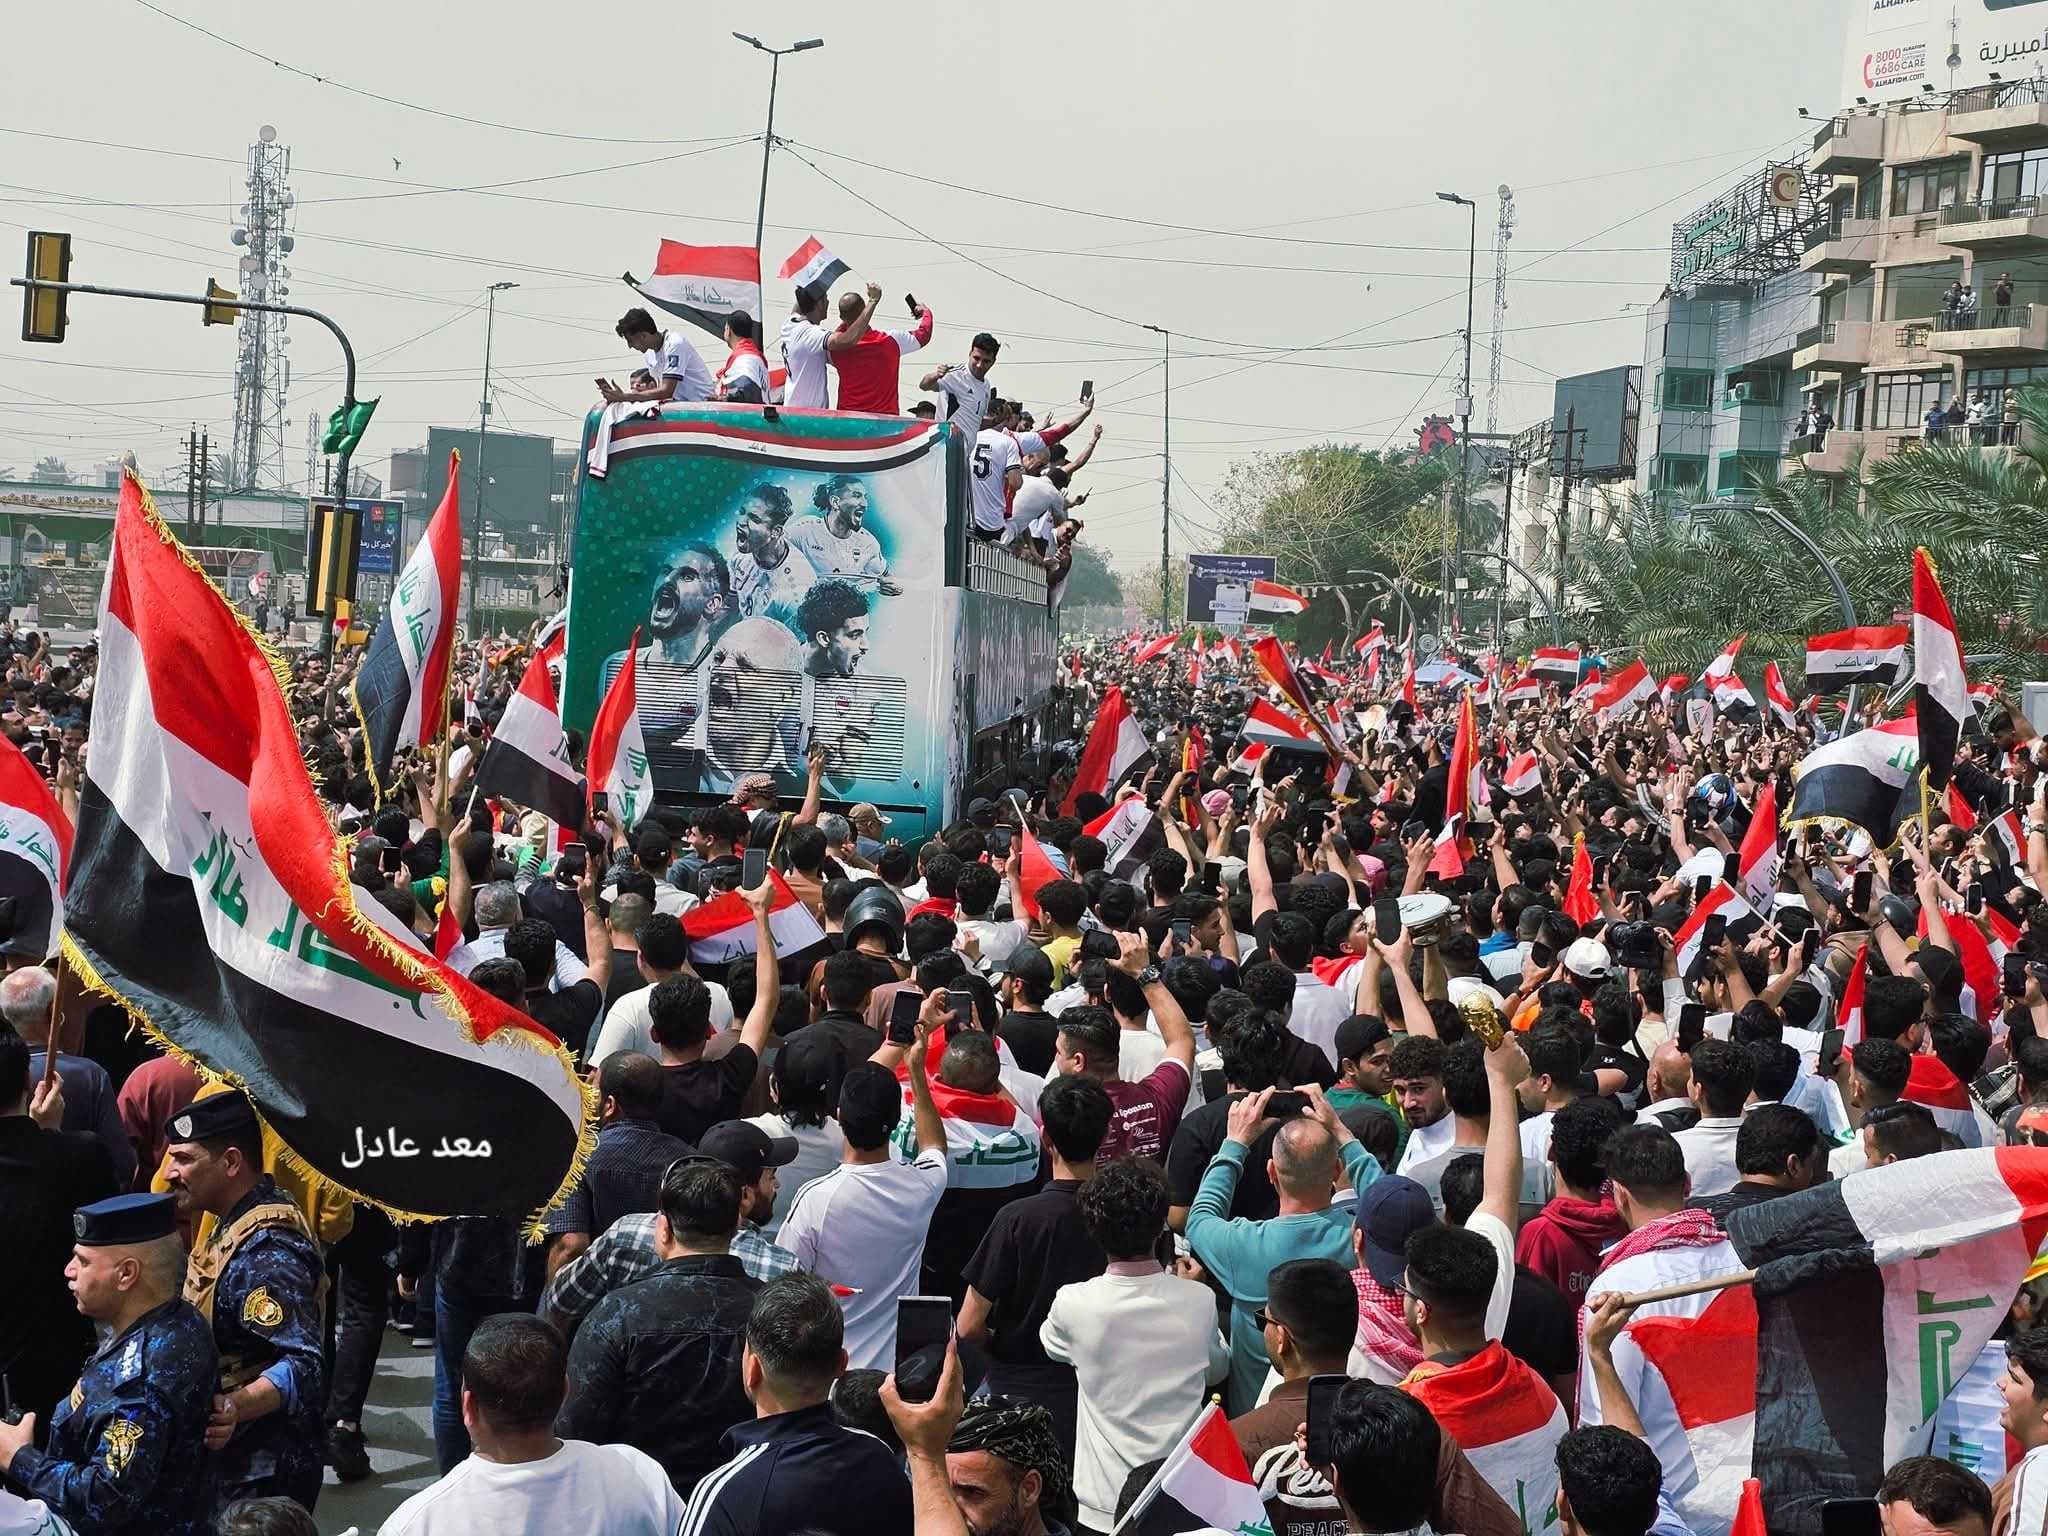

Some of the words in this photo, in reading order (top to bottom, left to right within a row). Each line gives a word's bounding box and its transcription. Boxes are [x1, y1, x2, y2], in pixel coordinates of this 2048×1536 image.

[1875, 48, 1902, 63] 8000
[1875, 61, 1901, 75] 6686
[1902, 58, 1926, 70] CARE
[973, 443, 992, 481] 5
